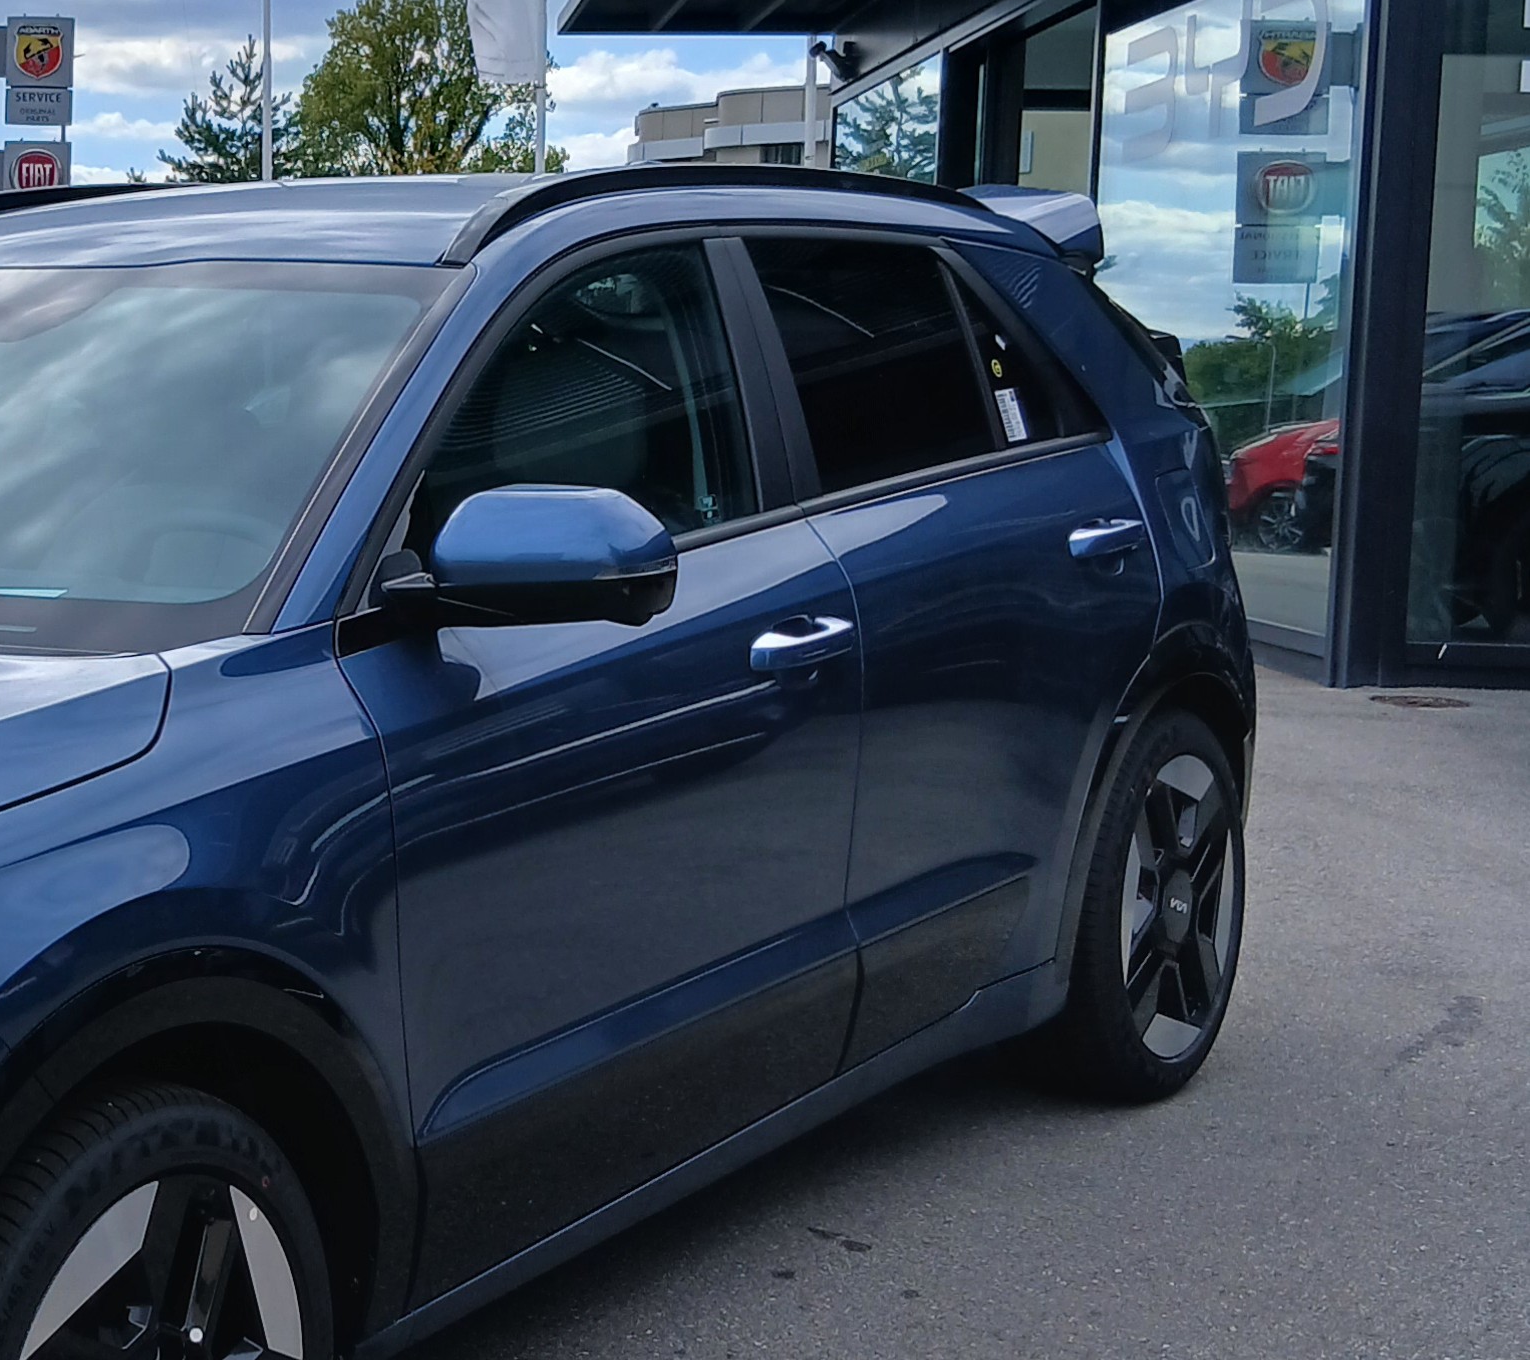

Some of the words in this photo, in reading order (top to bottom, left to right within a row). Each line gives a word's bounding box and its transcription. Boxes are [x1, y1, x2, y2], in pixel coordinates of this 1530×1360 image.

[19, 26, 60, 35] ABARTH
[15, 92, 62, 103] SERVICE
[21, 162, 54, 188] FIAT
